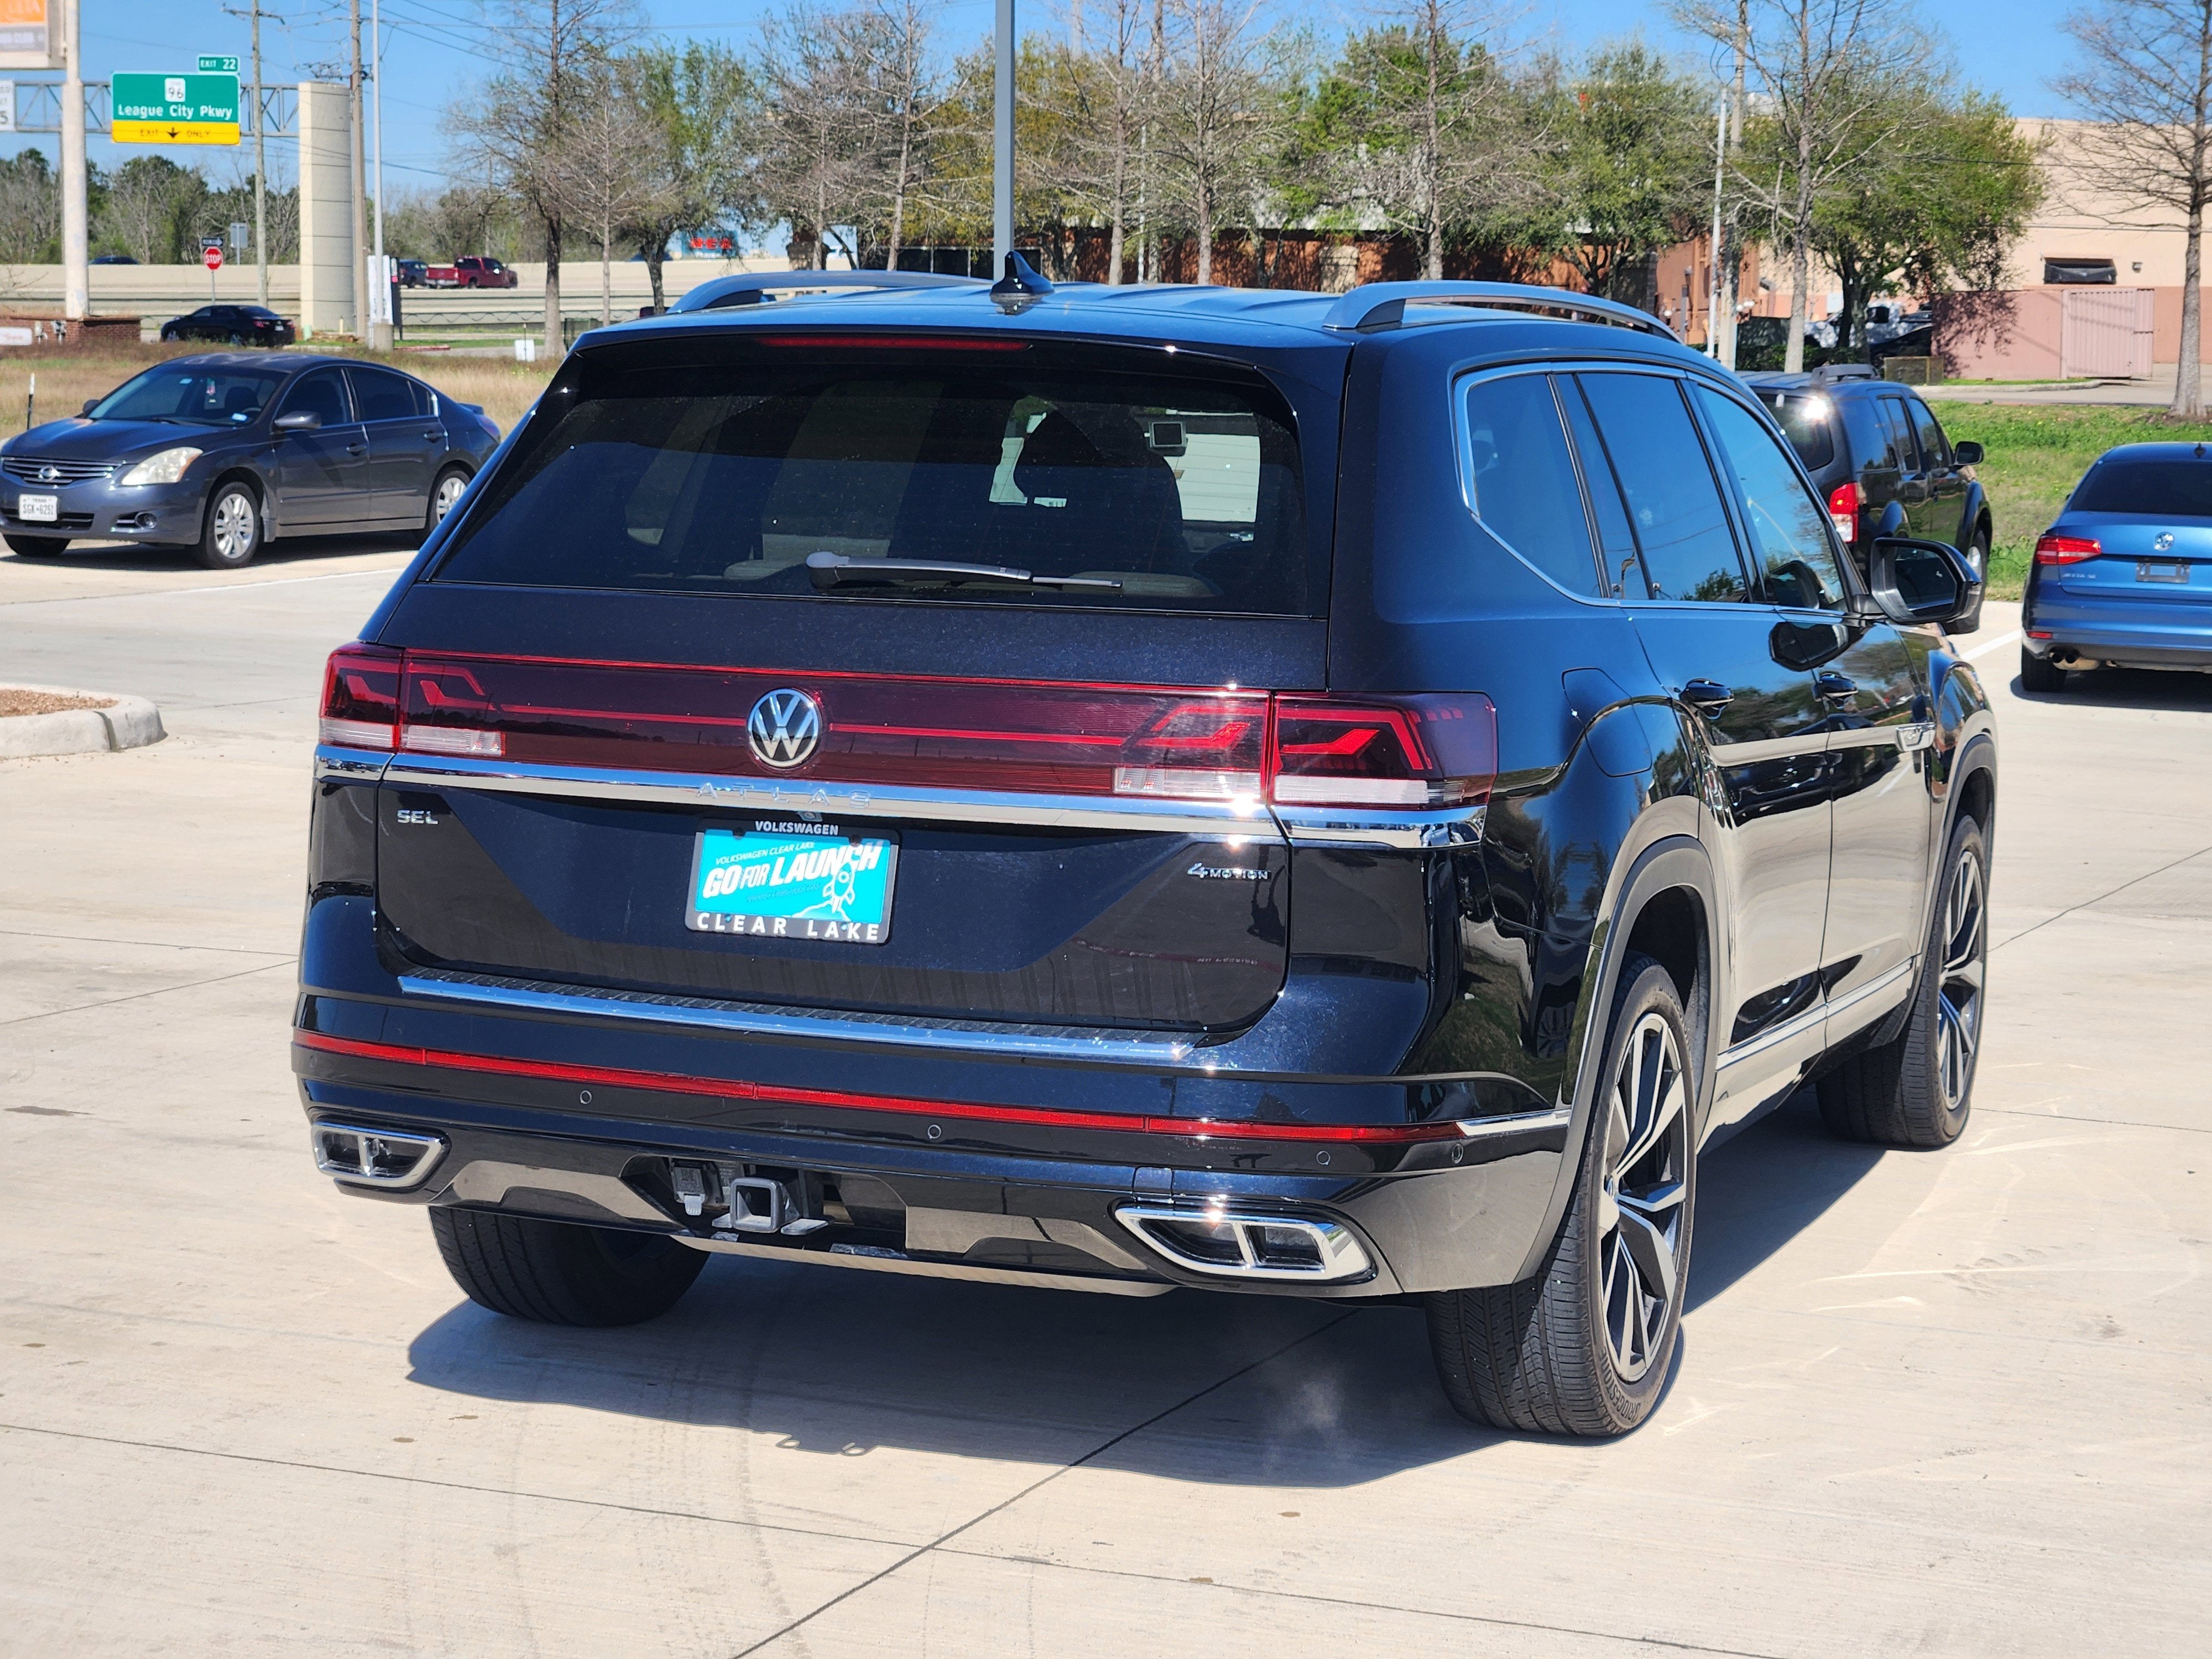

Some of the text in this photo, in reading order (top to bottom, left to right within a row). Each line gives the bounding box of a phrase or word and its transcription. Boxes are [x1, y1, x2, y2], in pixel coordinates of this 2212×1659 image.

[222, 59, 236, 70] 22
[168, 87, 184, 99] 96
[118, 103, 233, 121] League City Pkwy
[186, 129, 211, 138] ONLY
[205, 254, 222, 264] STOP
[695, 781, 871, 809] ATLAS
[397, 810, 439, 825] SEL
[755, 820, 839, 836] VOLKSWAGEN
[715, 841, 816, 865] VOLKSWAGEN CLEAR LAKE
[702, 864, 743, 899] GO
[739, 863, 770, 890] FOR
[769, 839, 884, 886] LAUNCH
[697, 912, 880, 941] CLEAR LAKE
[1598, 1345, 1642, 1423] BRIDGESTONE
